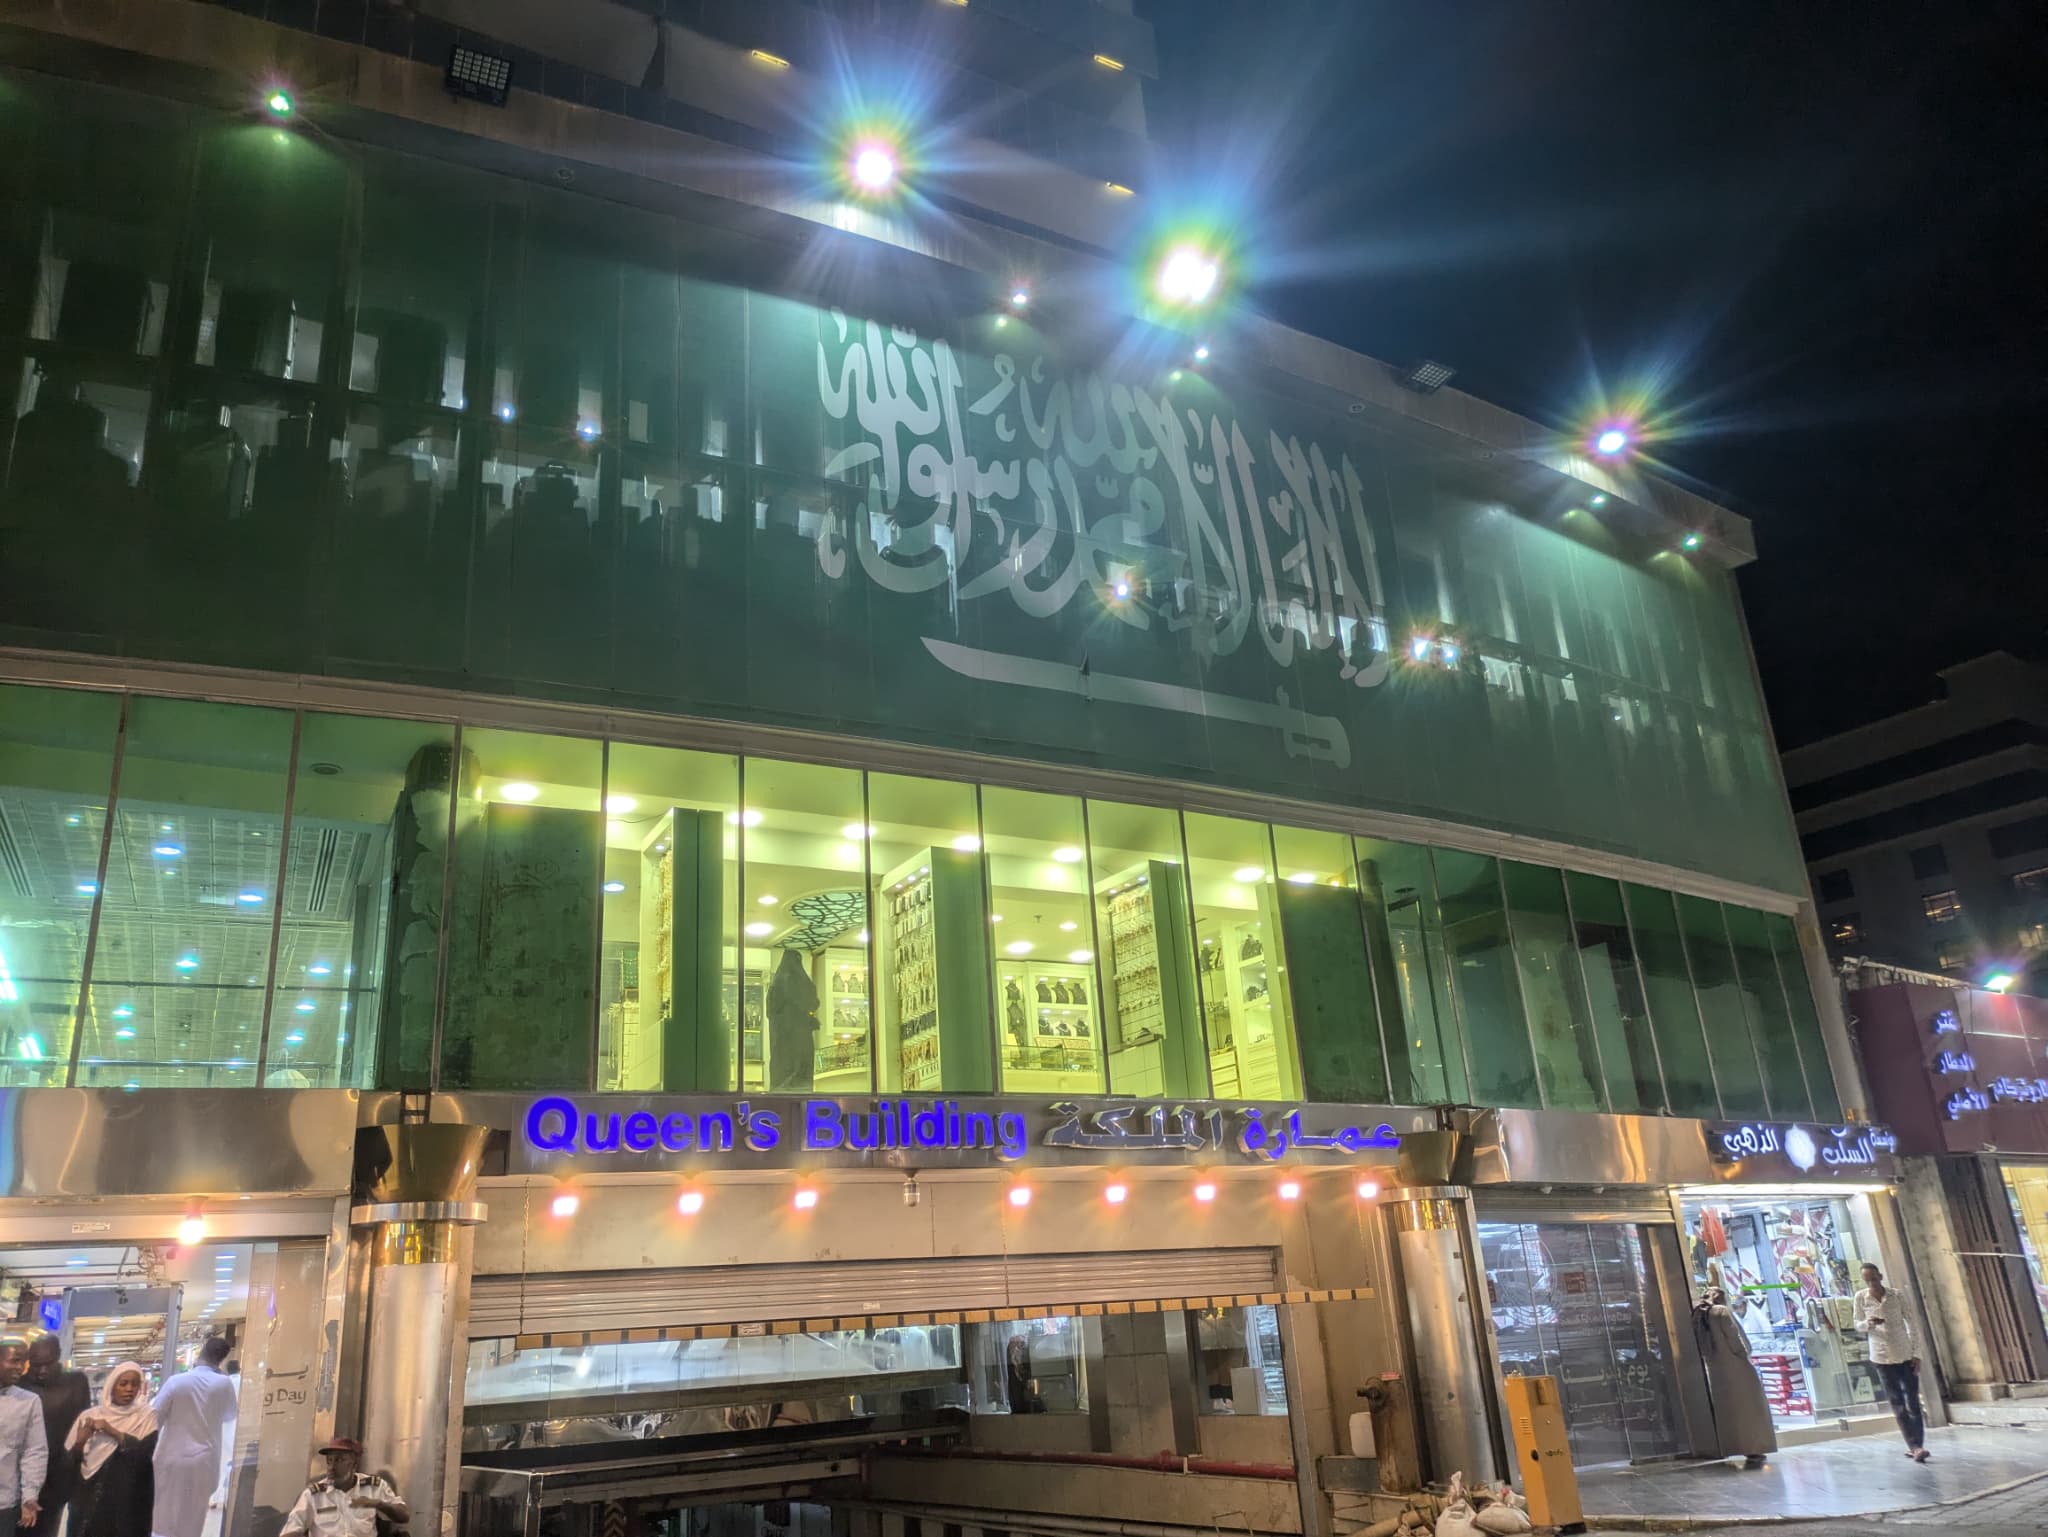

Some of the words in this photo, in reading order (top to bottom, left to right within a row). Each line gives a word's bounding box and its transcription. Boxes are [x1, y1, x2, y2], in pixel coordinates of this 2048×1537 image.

[526, 1096, 781, 1154] Queen's
[803, 1100, 1028, 1160] Building
[1043, 1102, 1224, 1150] الملكة
[1235, 1106, 1401, 1161] عمارة
[1724, 1123, 1780, 1161] الذهبي
[276, 1388, 307, 1404] Day
